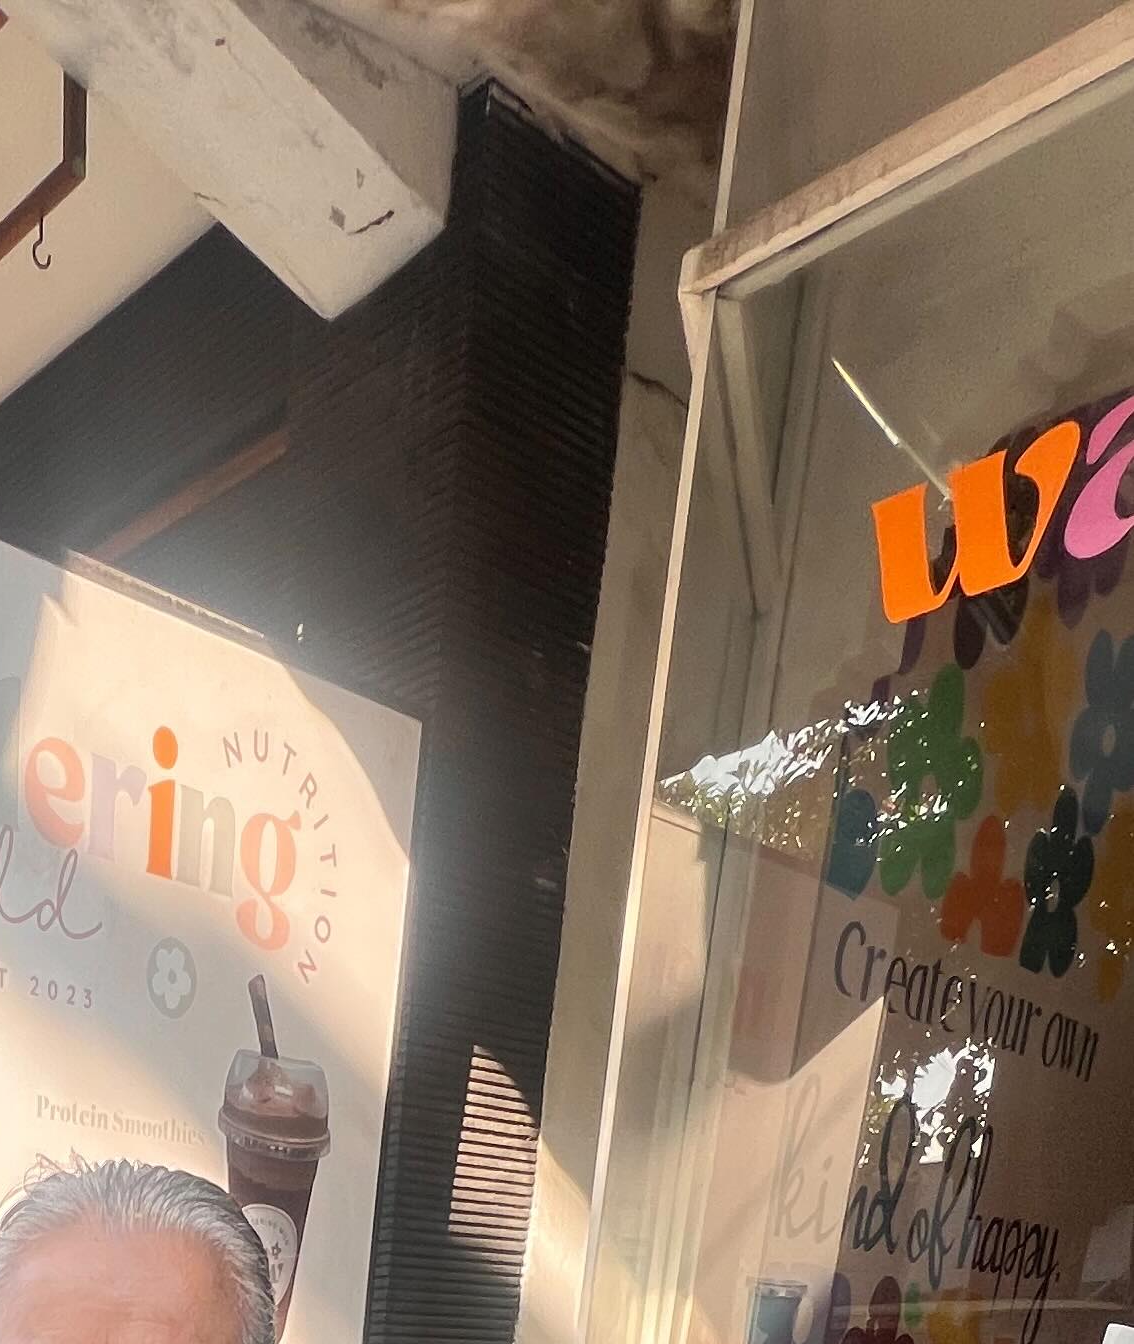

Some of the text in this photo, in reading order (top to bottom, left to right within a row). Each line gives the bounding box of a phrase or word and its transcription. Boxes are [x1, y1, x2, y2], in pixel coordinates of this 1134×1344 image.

[222, 728, 338, 985] NUTRITION
[29, 975, 93, 1009] 2023
[834, 920, 1100, 1083] Create your own
[35, 1094, 206, 1146] Protein Smoothies
[769, 1072, 919, 1256] kind
[906, 1116, 977, 1291] of
